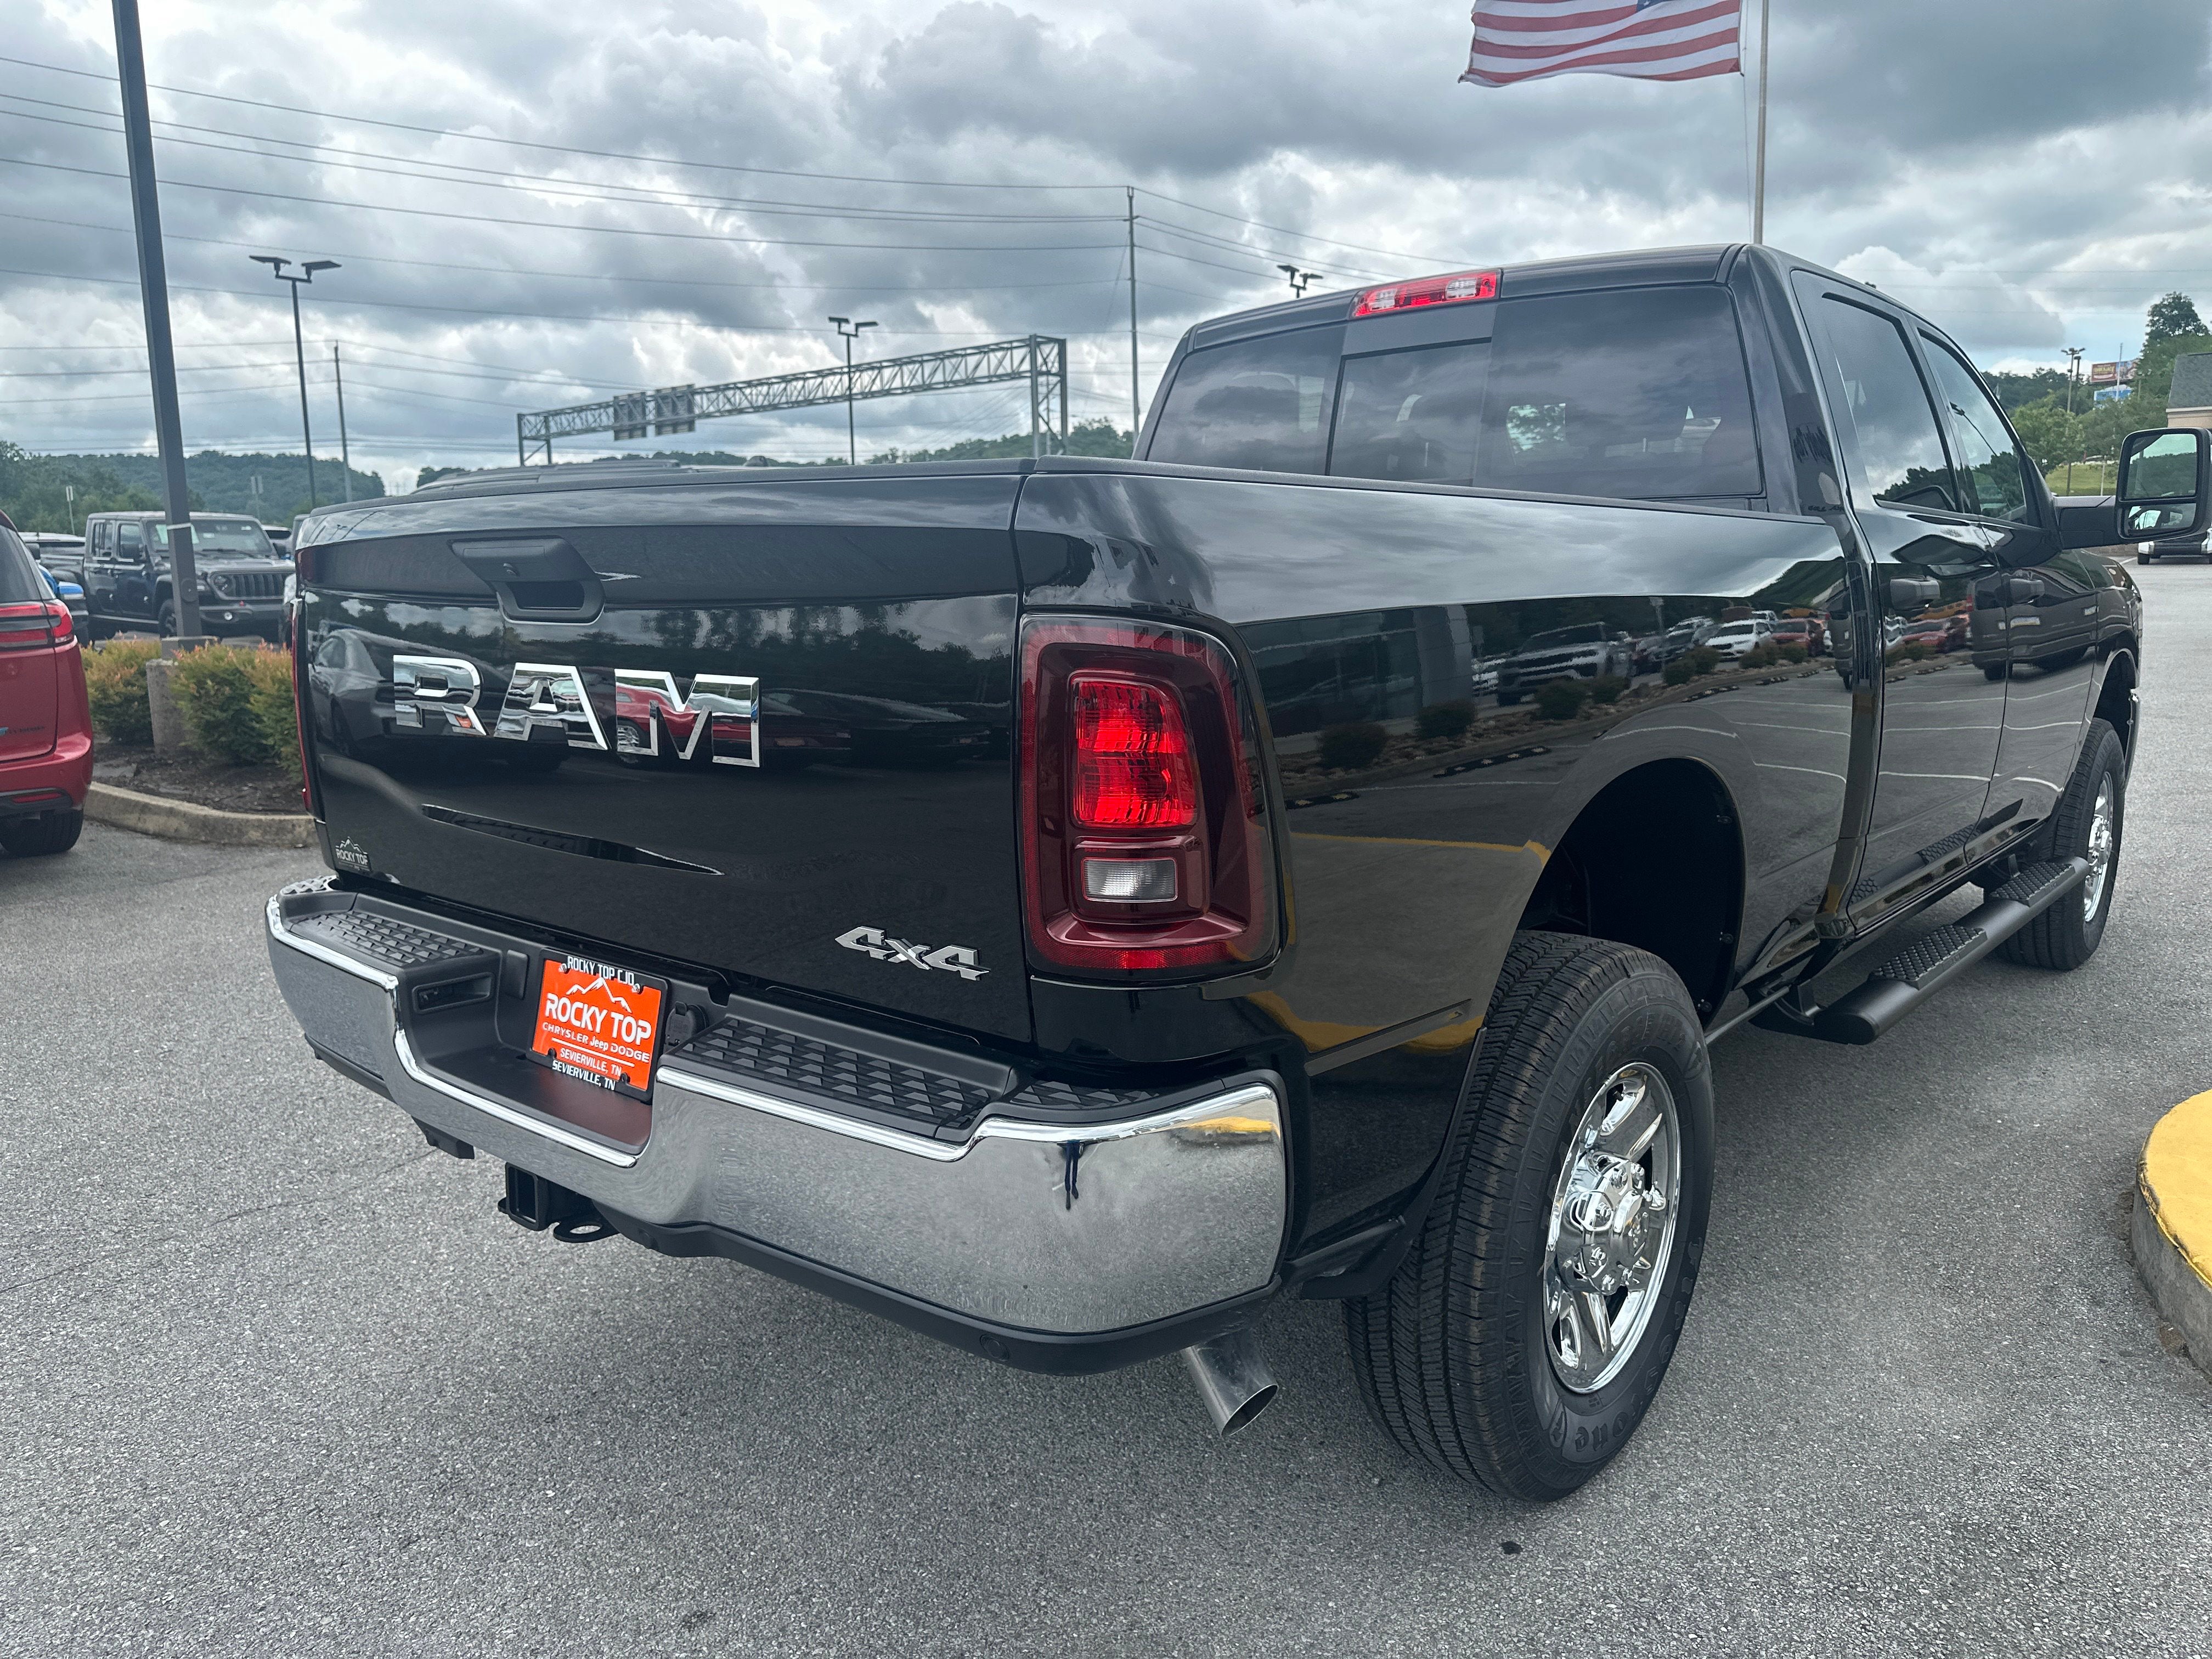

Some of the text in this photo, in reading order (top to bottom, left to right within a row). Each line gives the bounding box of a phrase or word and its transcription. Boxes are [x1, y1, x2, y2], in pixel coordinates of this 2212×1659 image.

[393, 654, 760, 768] RAM
[335, 848, 368, 865] ROCKY TOP
[567, 956, 595, 976] ROCKY
[597, 964, 615, 980] TOP
[545, 992, 652, 1046] ROCKY TOP
[543, 1022, 651, 1064] CHRYSLER Jeep DODGE
[552, 1059, 616, 1091] SEVIERVILLE, TN
[560, 1047, 623, 1077] SEVIERVILLE, TN
